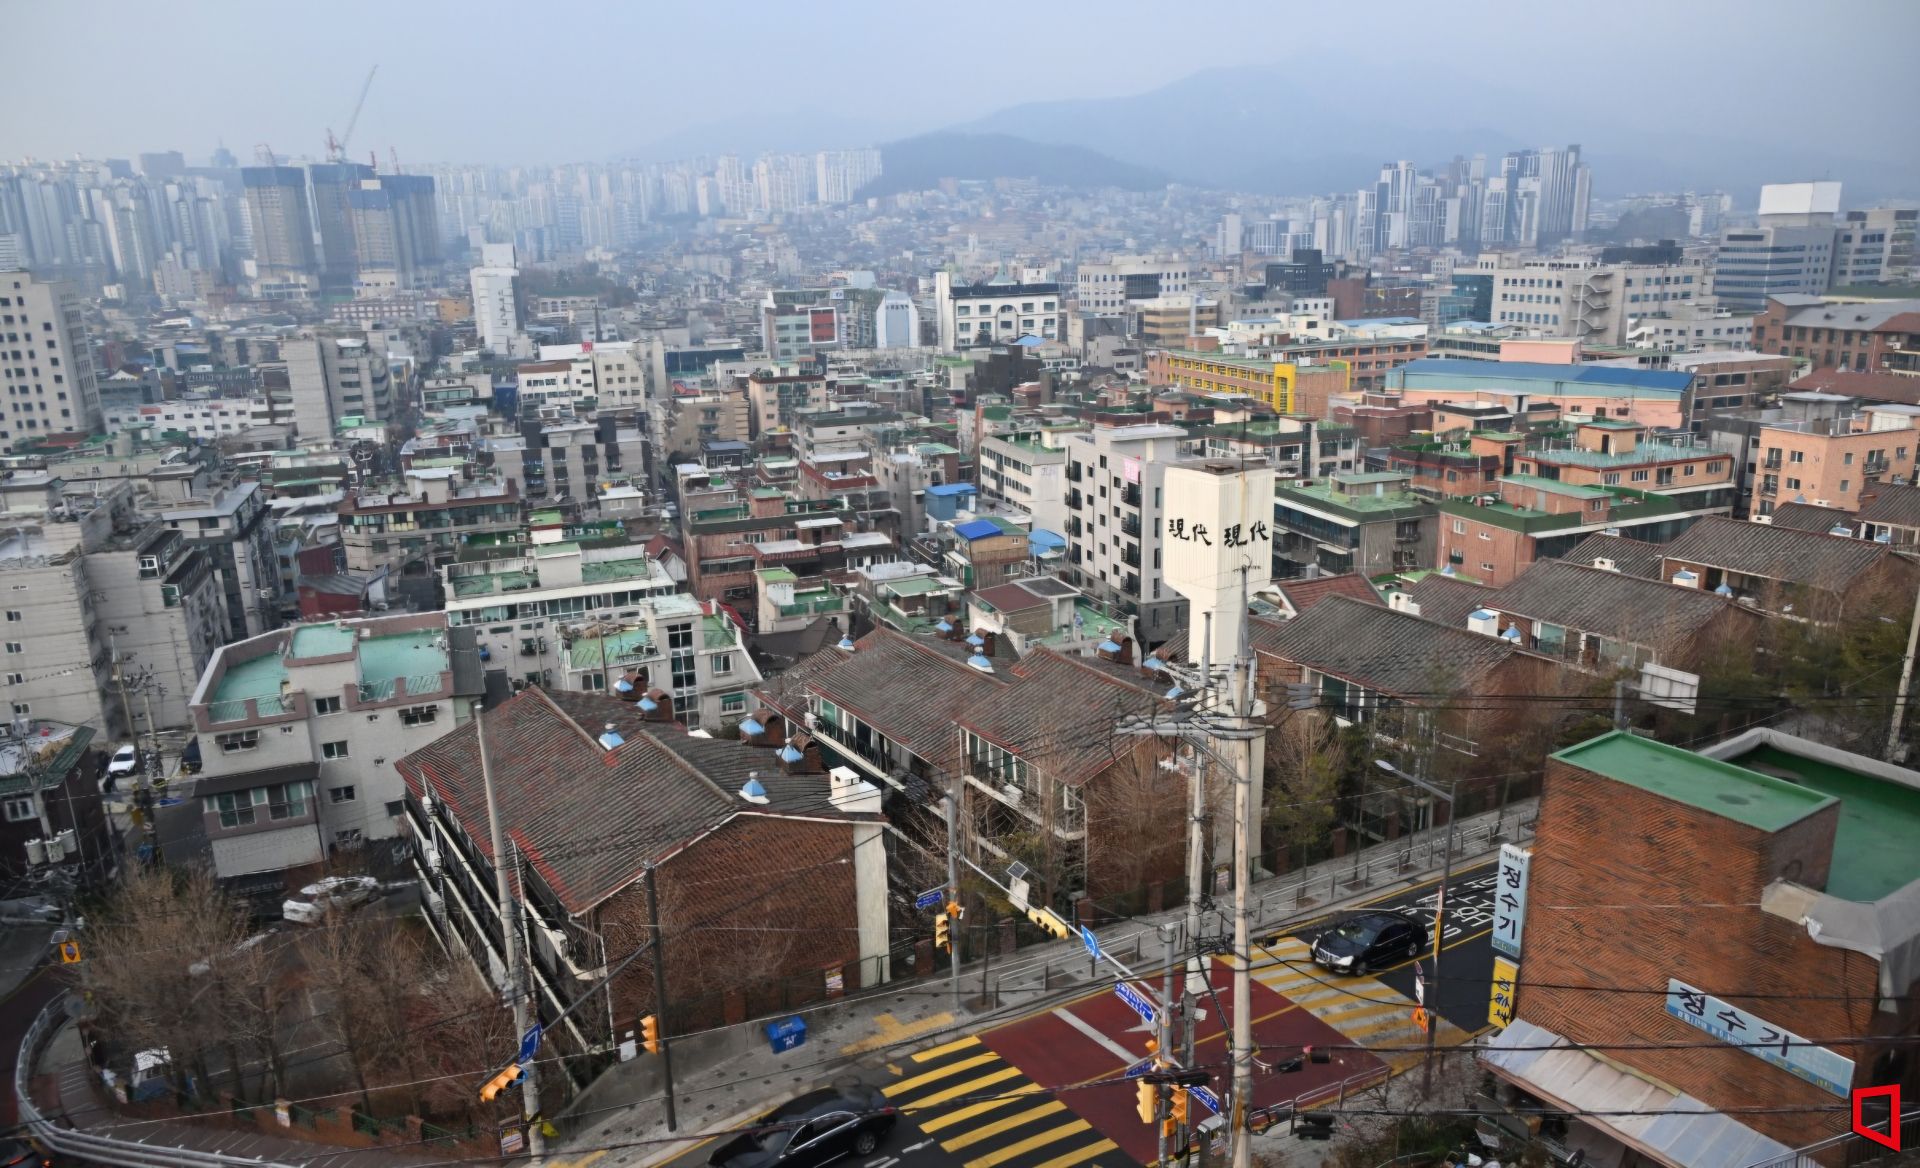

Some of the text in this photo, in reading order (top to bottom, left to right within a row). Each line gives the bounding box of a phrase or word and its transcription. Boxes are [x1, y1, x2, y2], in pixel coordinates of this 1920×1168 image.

[1168, 518, 1212, 546] 現代
[1224, 520, 1269, 548] 現代
[1498, 864, 1521, 940] 정수기
[1678, 986, 1790, 1057] 정수기
